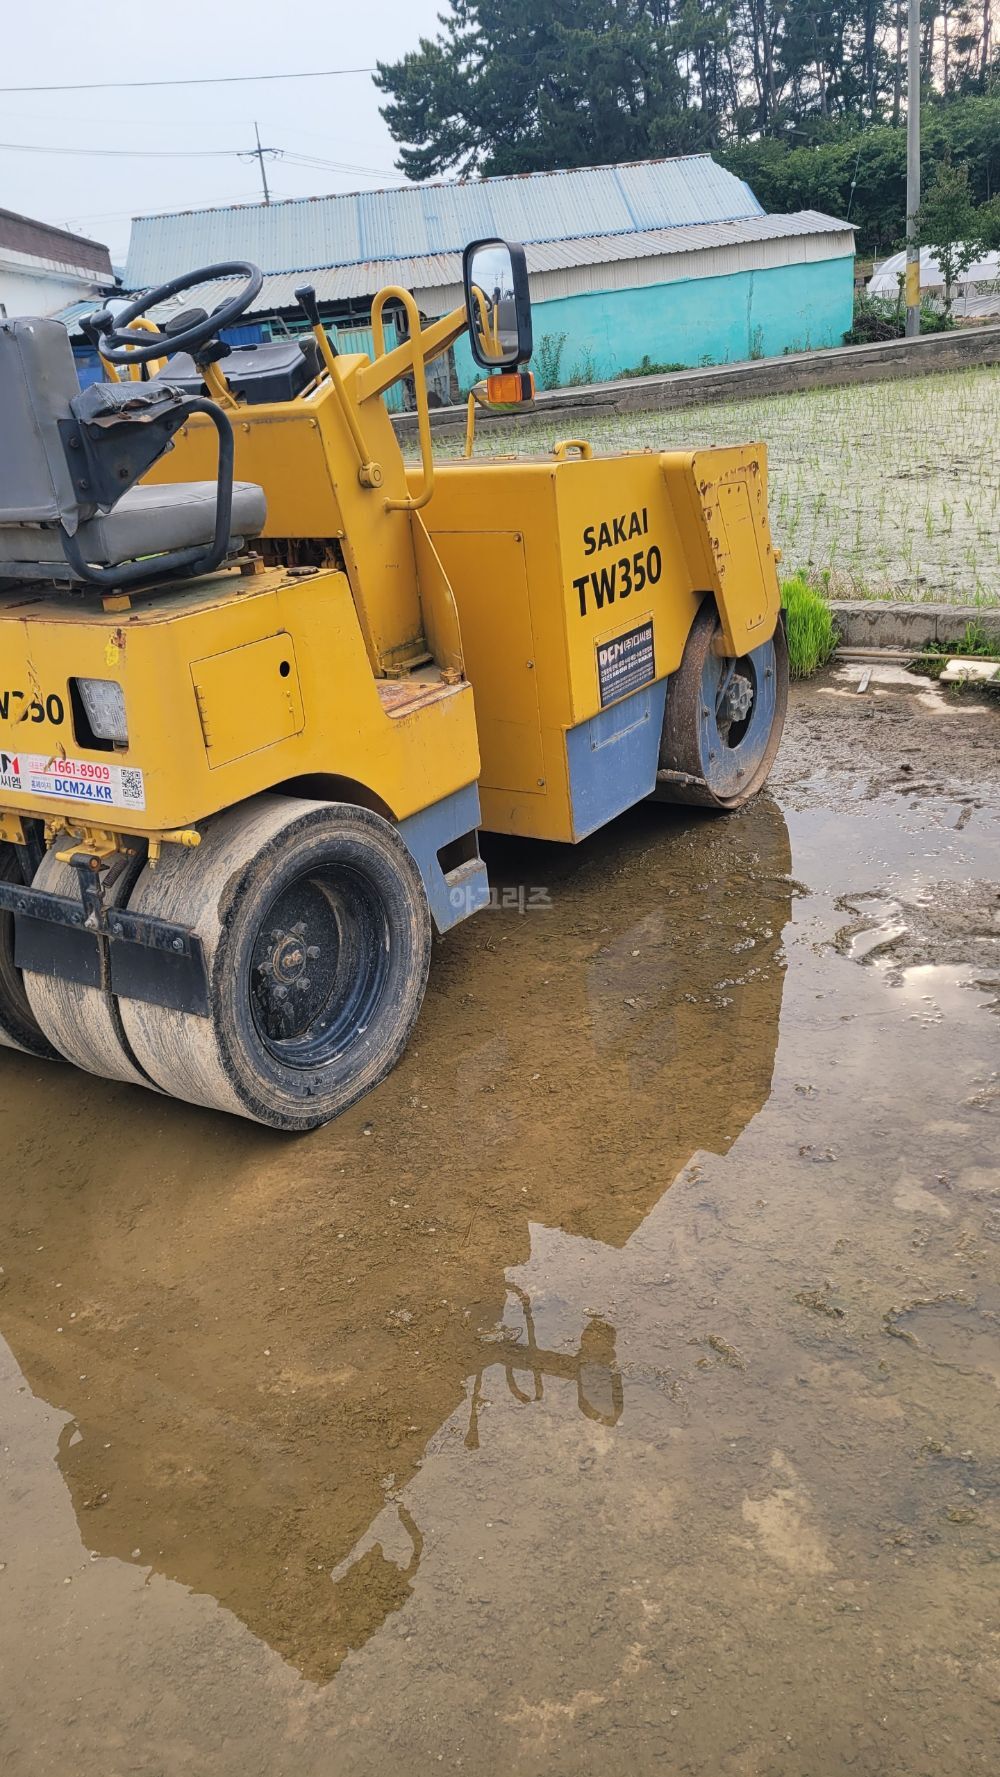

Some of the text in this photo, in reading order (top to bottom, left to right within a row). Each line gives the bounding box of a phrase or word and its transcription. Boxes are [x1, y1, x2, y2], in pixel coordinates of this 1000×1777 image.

[583, 507, 648, 556] SAKAI
[572, 545, 662, 617] TW350
[53, 760, 110, 780] 1661-8909
[54, 779, 112, 800] DCM24.KR
